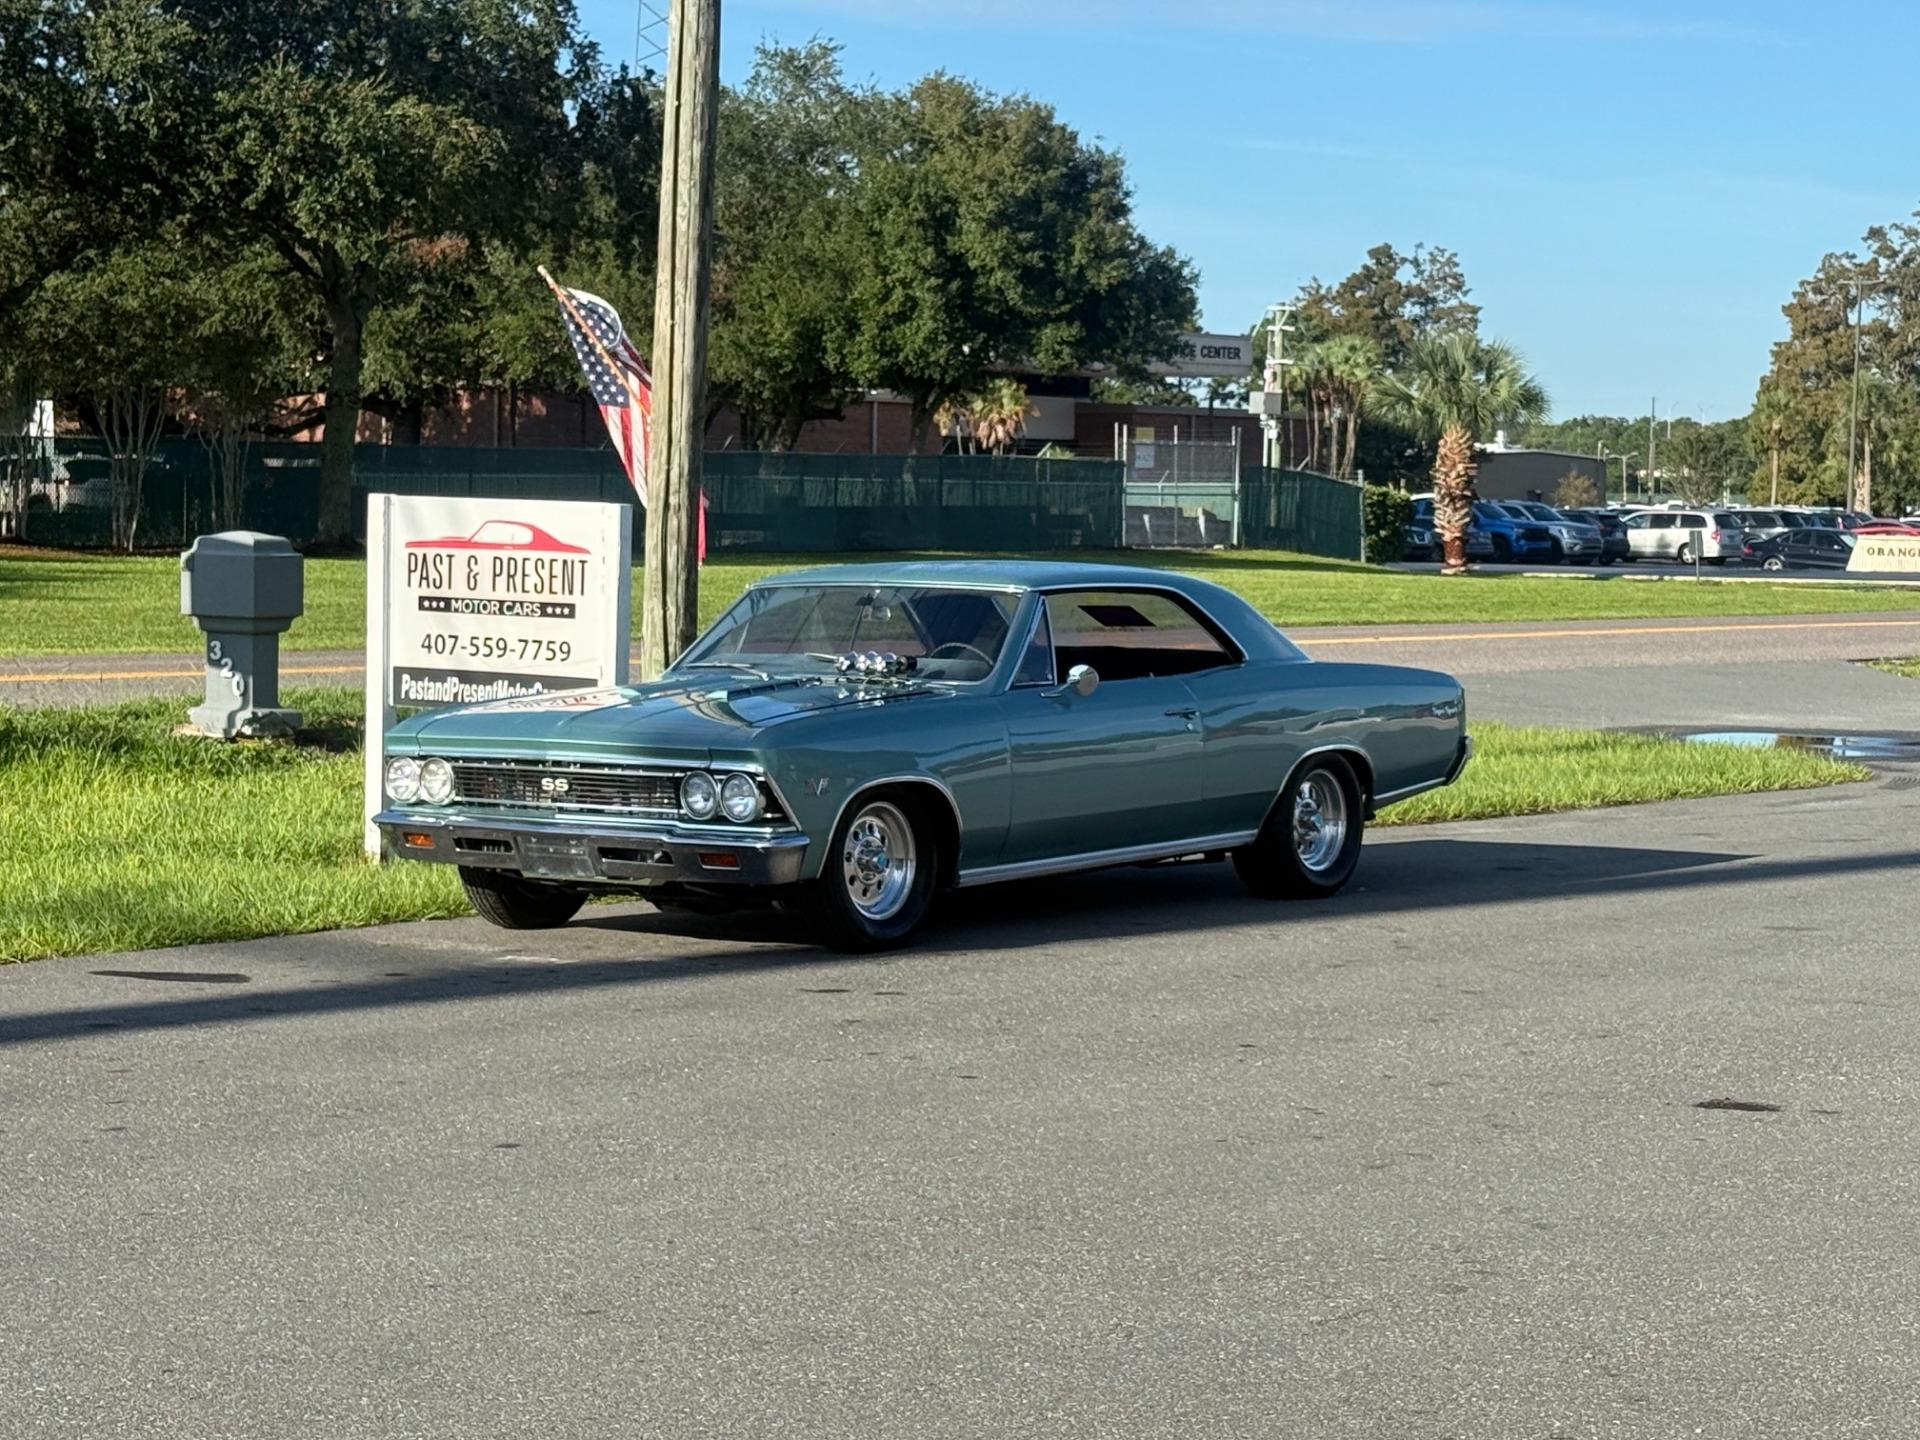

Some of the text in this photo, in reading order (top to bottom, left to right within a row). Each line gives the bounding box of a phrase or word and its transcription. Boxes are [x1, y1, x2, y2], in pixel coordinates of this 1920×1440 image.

[1200, 345, 1241, 360] CENTER
[407, 552, 588, 596] PAST & PRESENT
[451, 599, 541, 617] MOTOR CARS
[421, 633, 571, 662] 407-559-7759
[541, 777, 569, 791] SS
